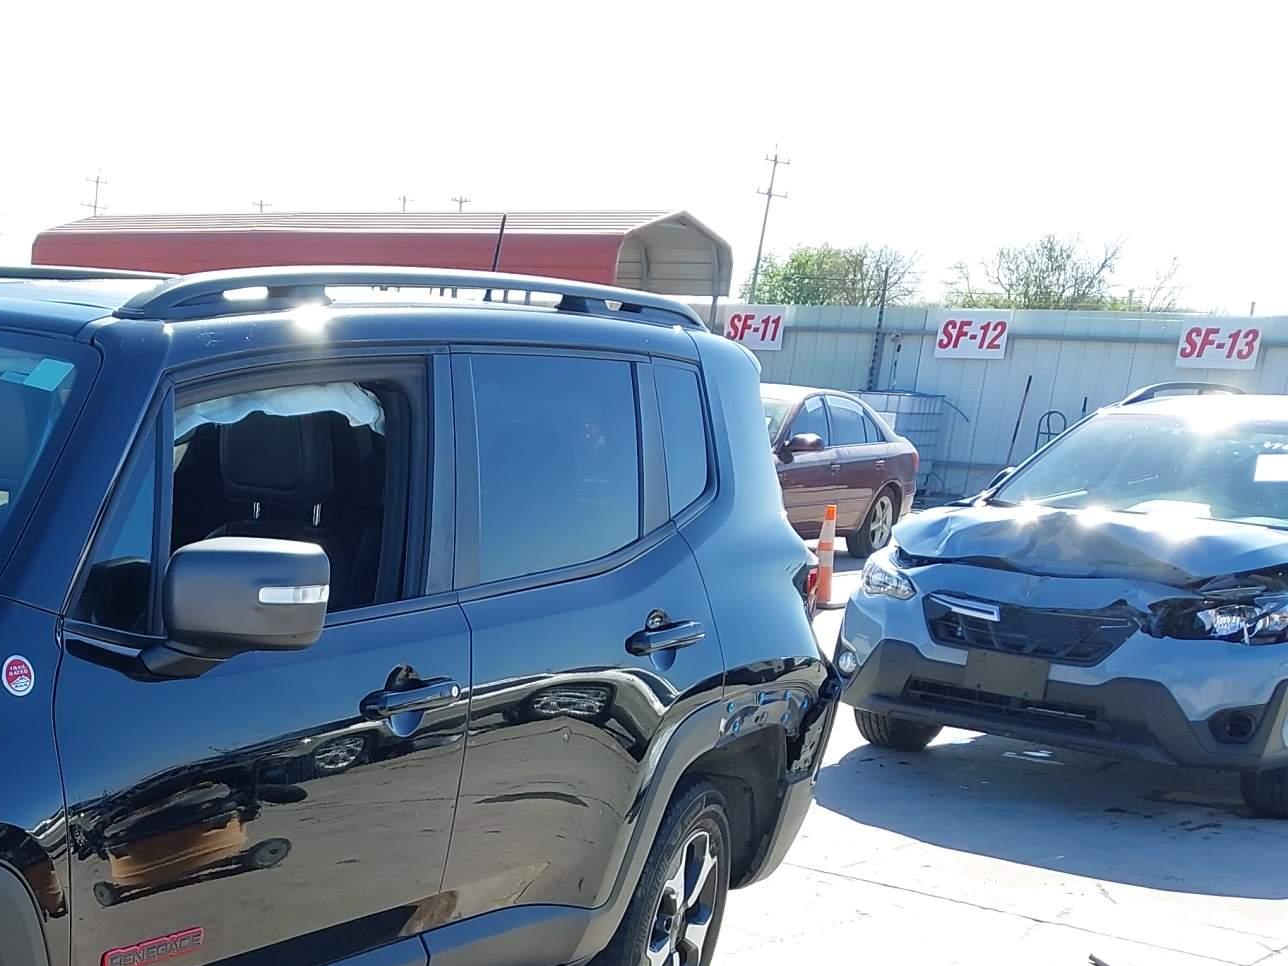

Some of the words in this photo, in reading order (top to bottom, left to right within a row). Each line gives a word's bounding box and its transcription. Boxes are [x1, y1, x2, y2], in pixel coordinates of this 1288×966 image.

[726, 313, 781, 342] SF-11
[937, 319, 1008, 350] SF-12
[1179, 327, 1259, 360] SF-13
